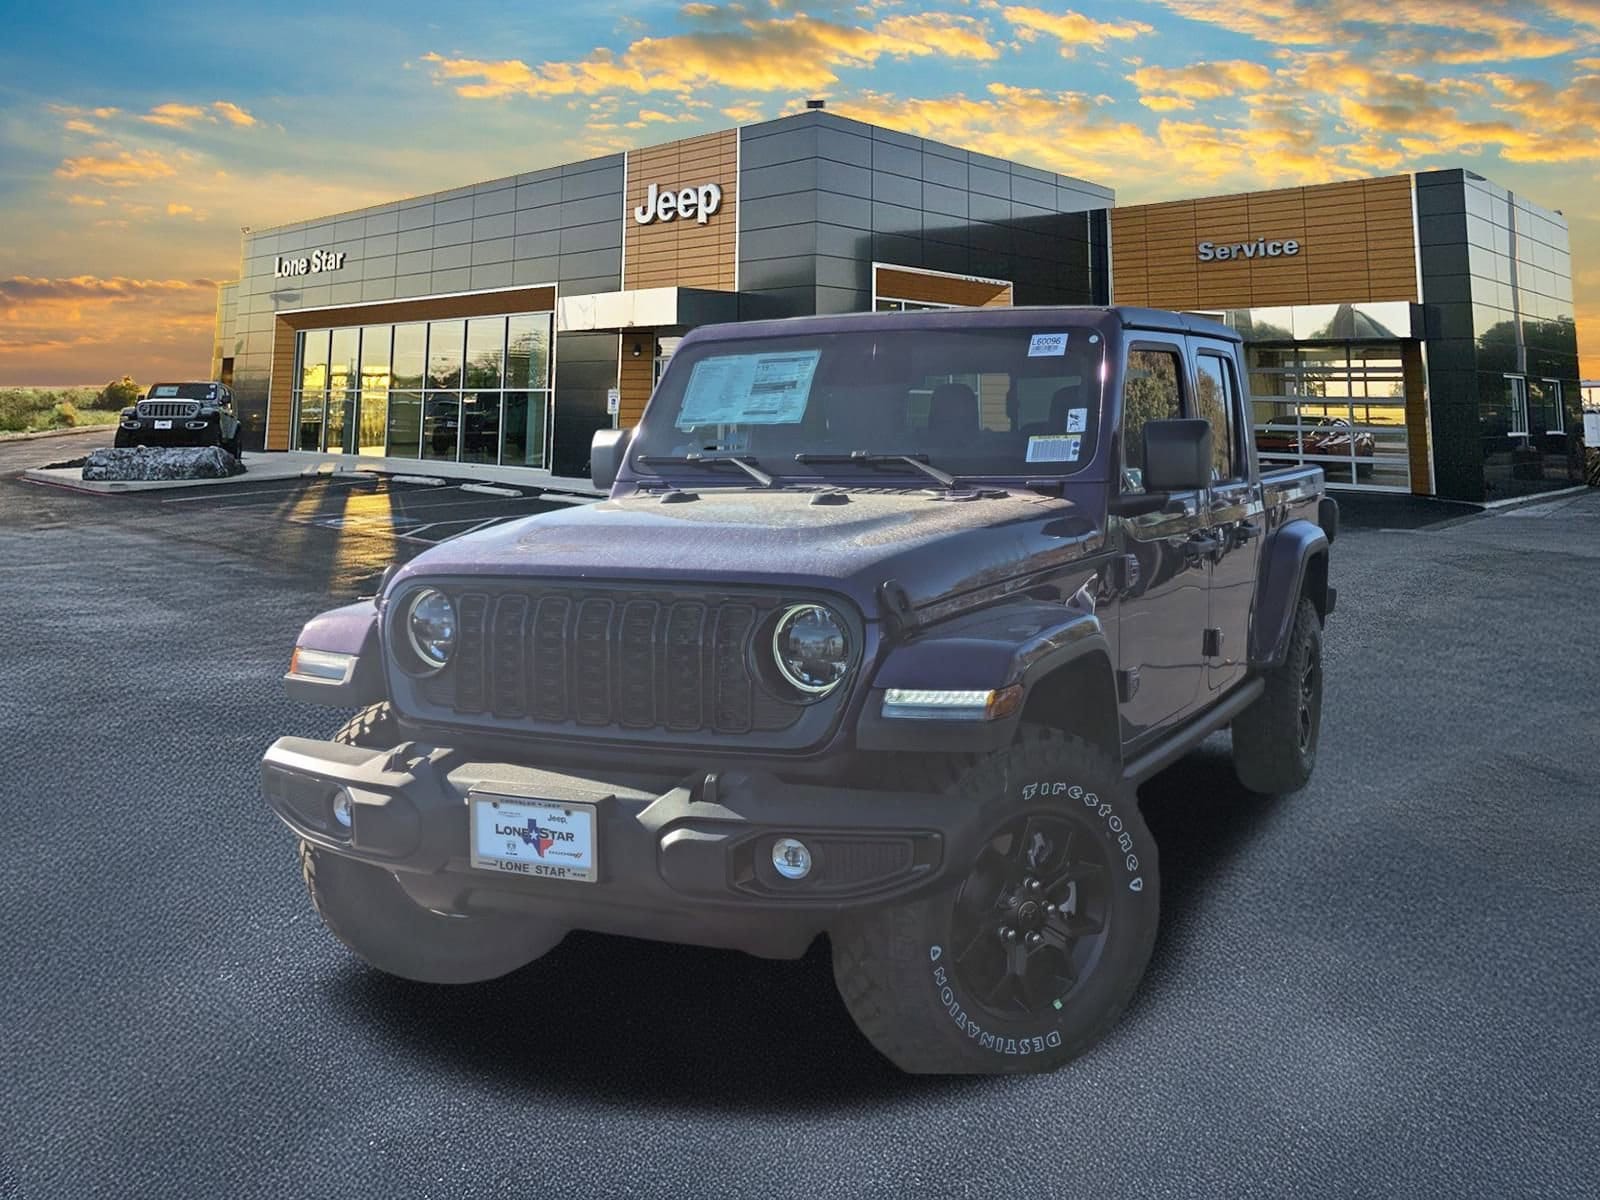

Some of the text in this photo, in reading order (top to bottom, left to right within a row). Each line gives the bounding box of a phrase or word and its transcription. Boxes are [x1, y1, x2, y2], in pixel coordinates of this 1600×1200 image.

[634, 183, 722, 224] Jeep
[1198, 236, 1299, 261] Service
[275, 249, 346, 279] Lone Star
[495, 823, 575, 842] LONE STAR
[1022, 782, 1139, 872] Firestone
[500, 860, 566, 878] LONE STAR
[933, 966, 1061, 1055] DESTINATION
